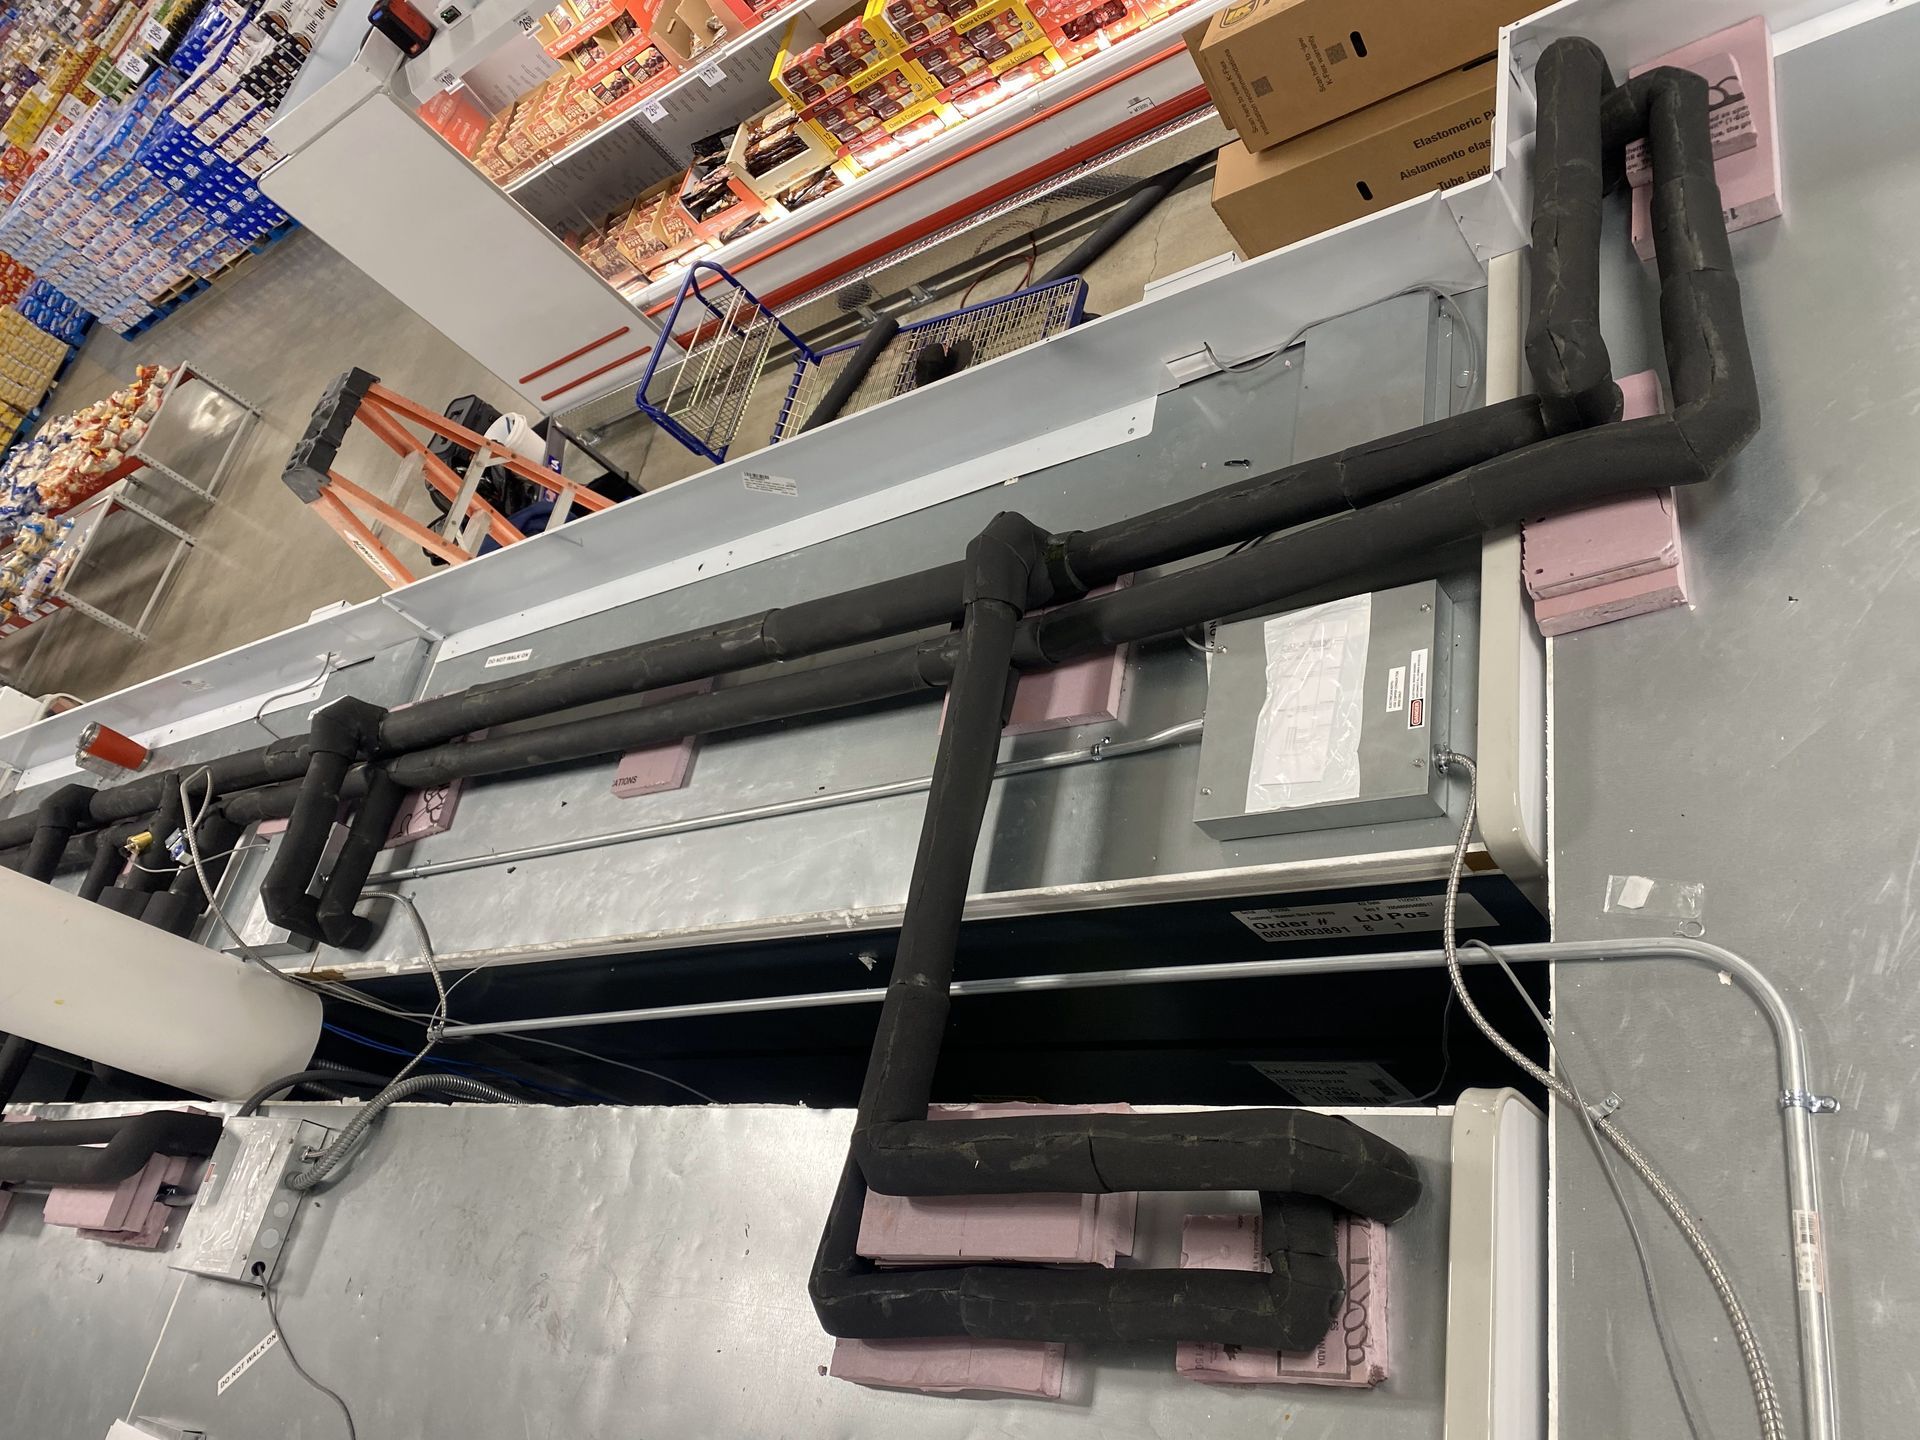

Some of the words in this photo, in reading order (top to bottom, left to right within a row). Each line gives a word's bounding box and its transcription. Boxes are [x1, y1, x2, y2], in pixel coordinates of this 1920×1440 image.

[959, 19, 973, 29] Cheese
[977, 7, 995, 20] Crackers
[1307, 34, 1322, 63] warranty
[996, 61, 1009, 71] Cheese
[1013, 49, 1032, 62] Crackers
[1308, 60, 1317, 75] here
[854, 79, 867, 88] Cheese
[871, 66, 888, 79] Crackers
[1315, 76, 1325, 92] Scan
[889, 119, 901, 128] Cheese
[904, 108, 921, 119] Crackers
[1241, 103, 1250, 117] here
[1247, 117, 1258, 133] Scan
[1413, 117, 1482, 149] Elastomeric
[1400, 149, 1466, 181] Aislamiento
[1437, 175, 1466, 191] Tube
[1253, 919, 1309, 930] Order
[1353, 914, 1384, 923] LU
[1386, 911, 1430, 920] Pos
[1262, 926, 1351, 938] 0001803891
[220, 1376, 230, 1388] DO
[231, 1361, 245, 1378] NOT
[246, 1343, 265, 1364] WALK
[266, 1333, 277, 1345] ON
[1317, 1337, 1327, 1369] ANADA.
